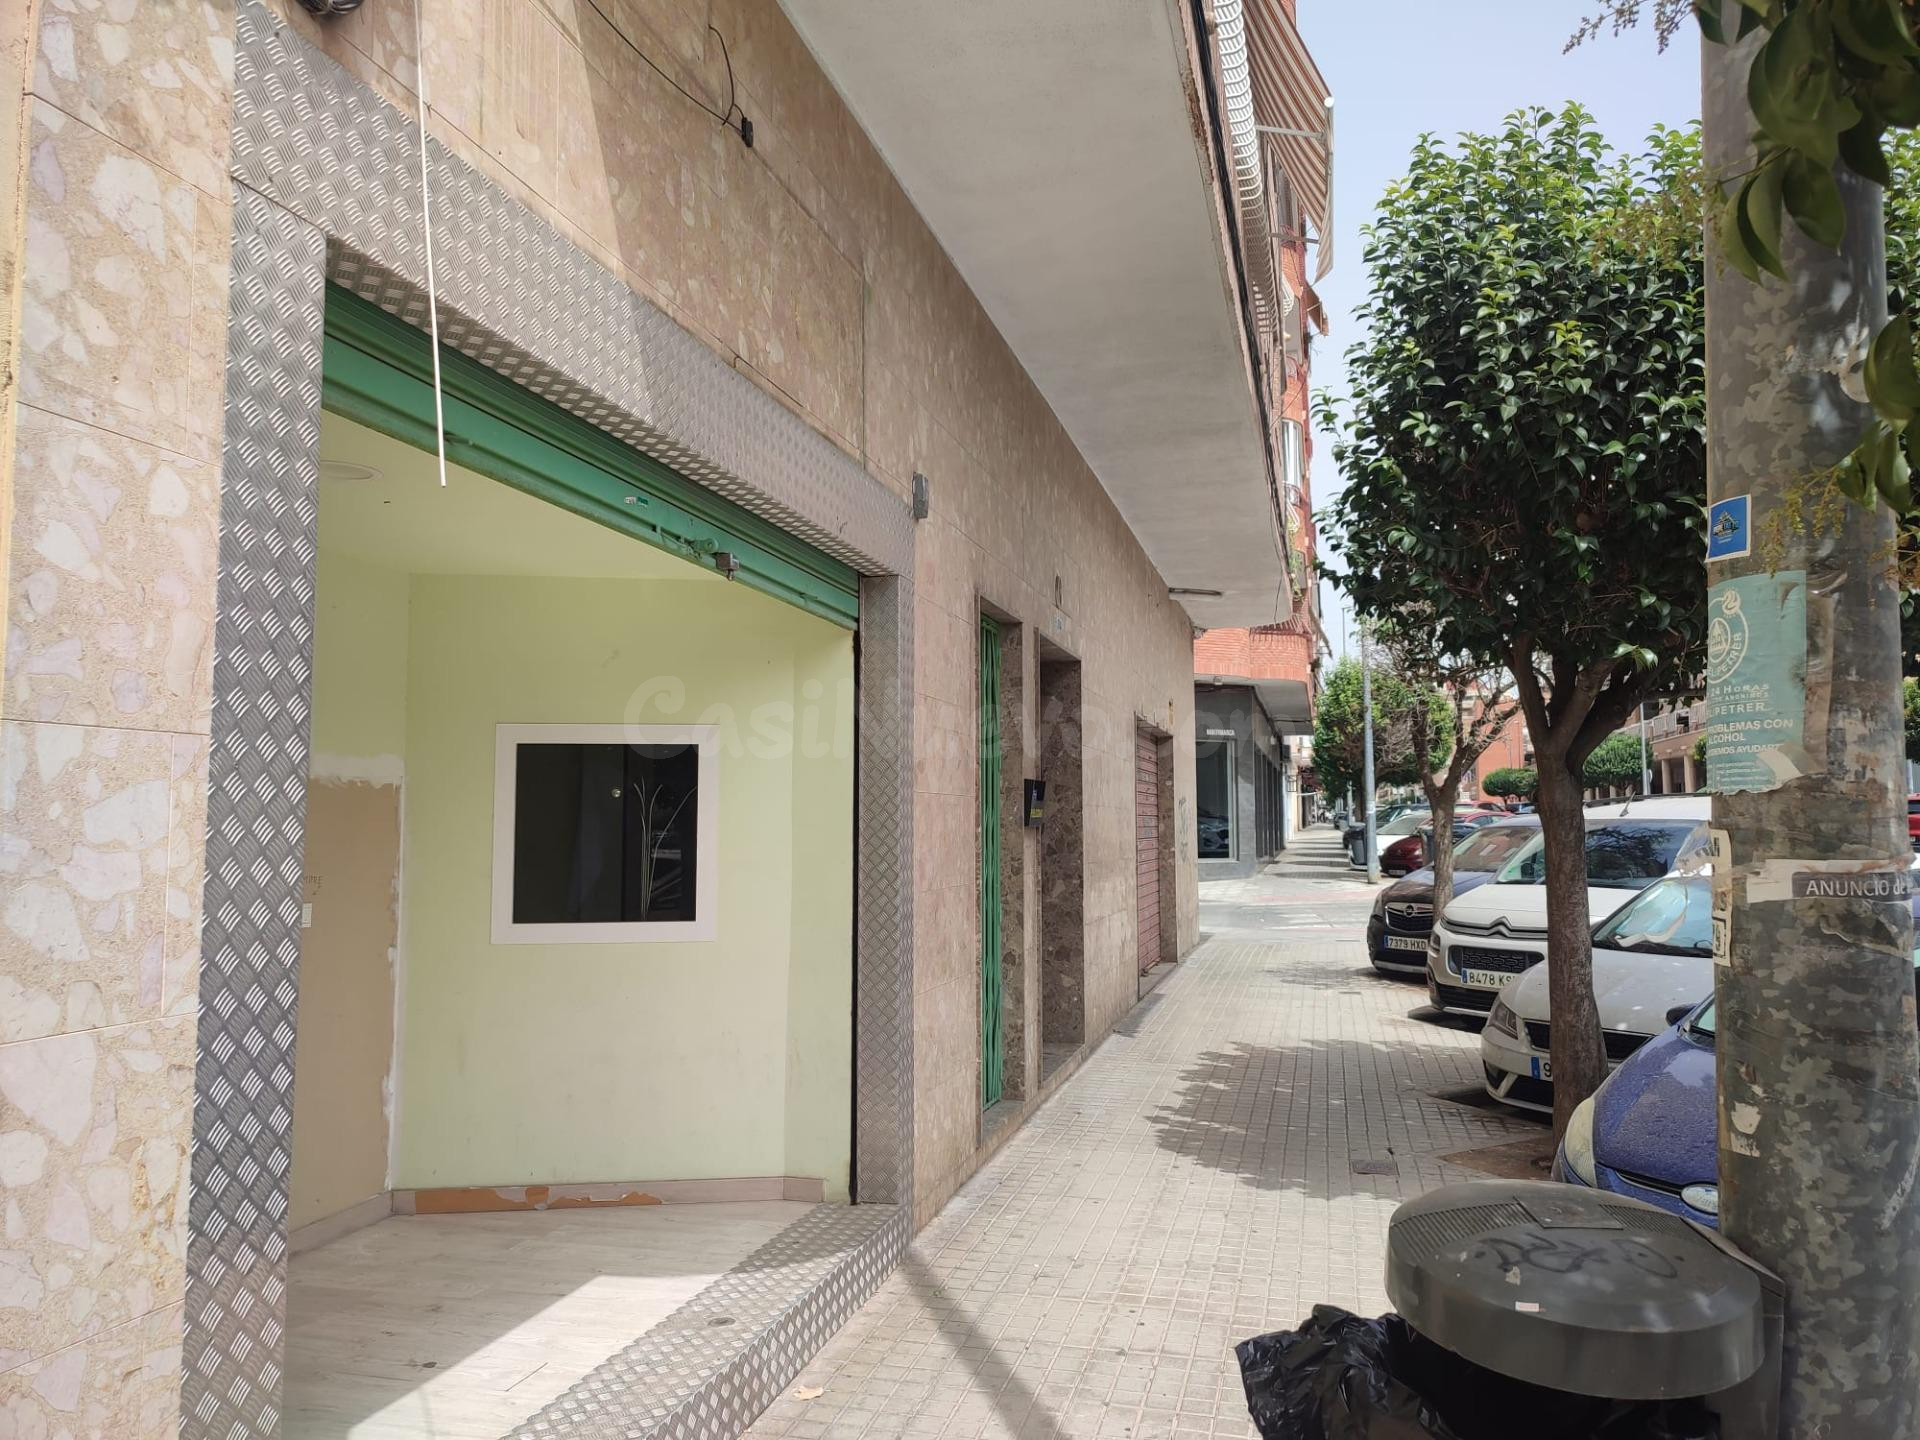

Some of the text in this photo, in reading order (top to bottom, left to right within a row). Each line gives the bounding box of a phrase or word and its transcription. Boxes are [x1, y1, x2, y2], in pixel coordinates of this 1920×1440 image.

[1707, 718, 1794, 734] ROBLEMAS CON
[1708, 732, 1745, 746] LCOHOL
[1806, 879, 1889, 897] ANUNCIO
[1389, 937, 1409, 949] 7379
[1469, 971, 1496, 985] 8478
[1543, 1062, 1552, 1078] 9
